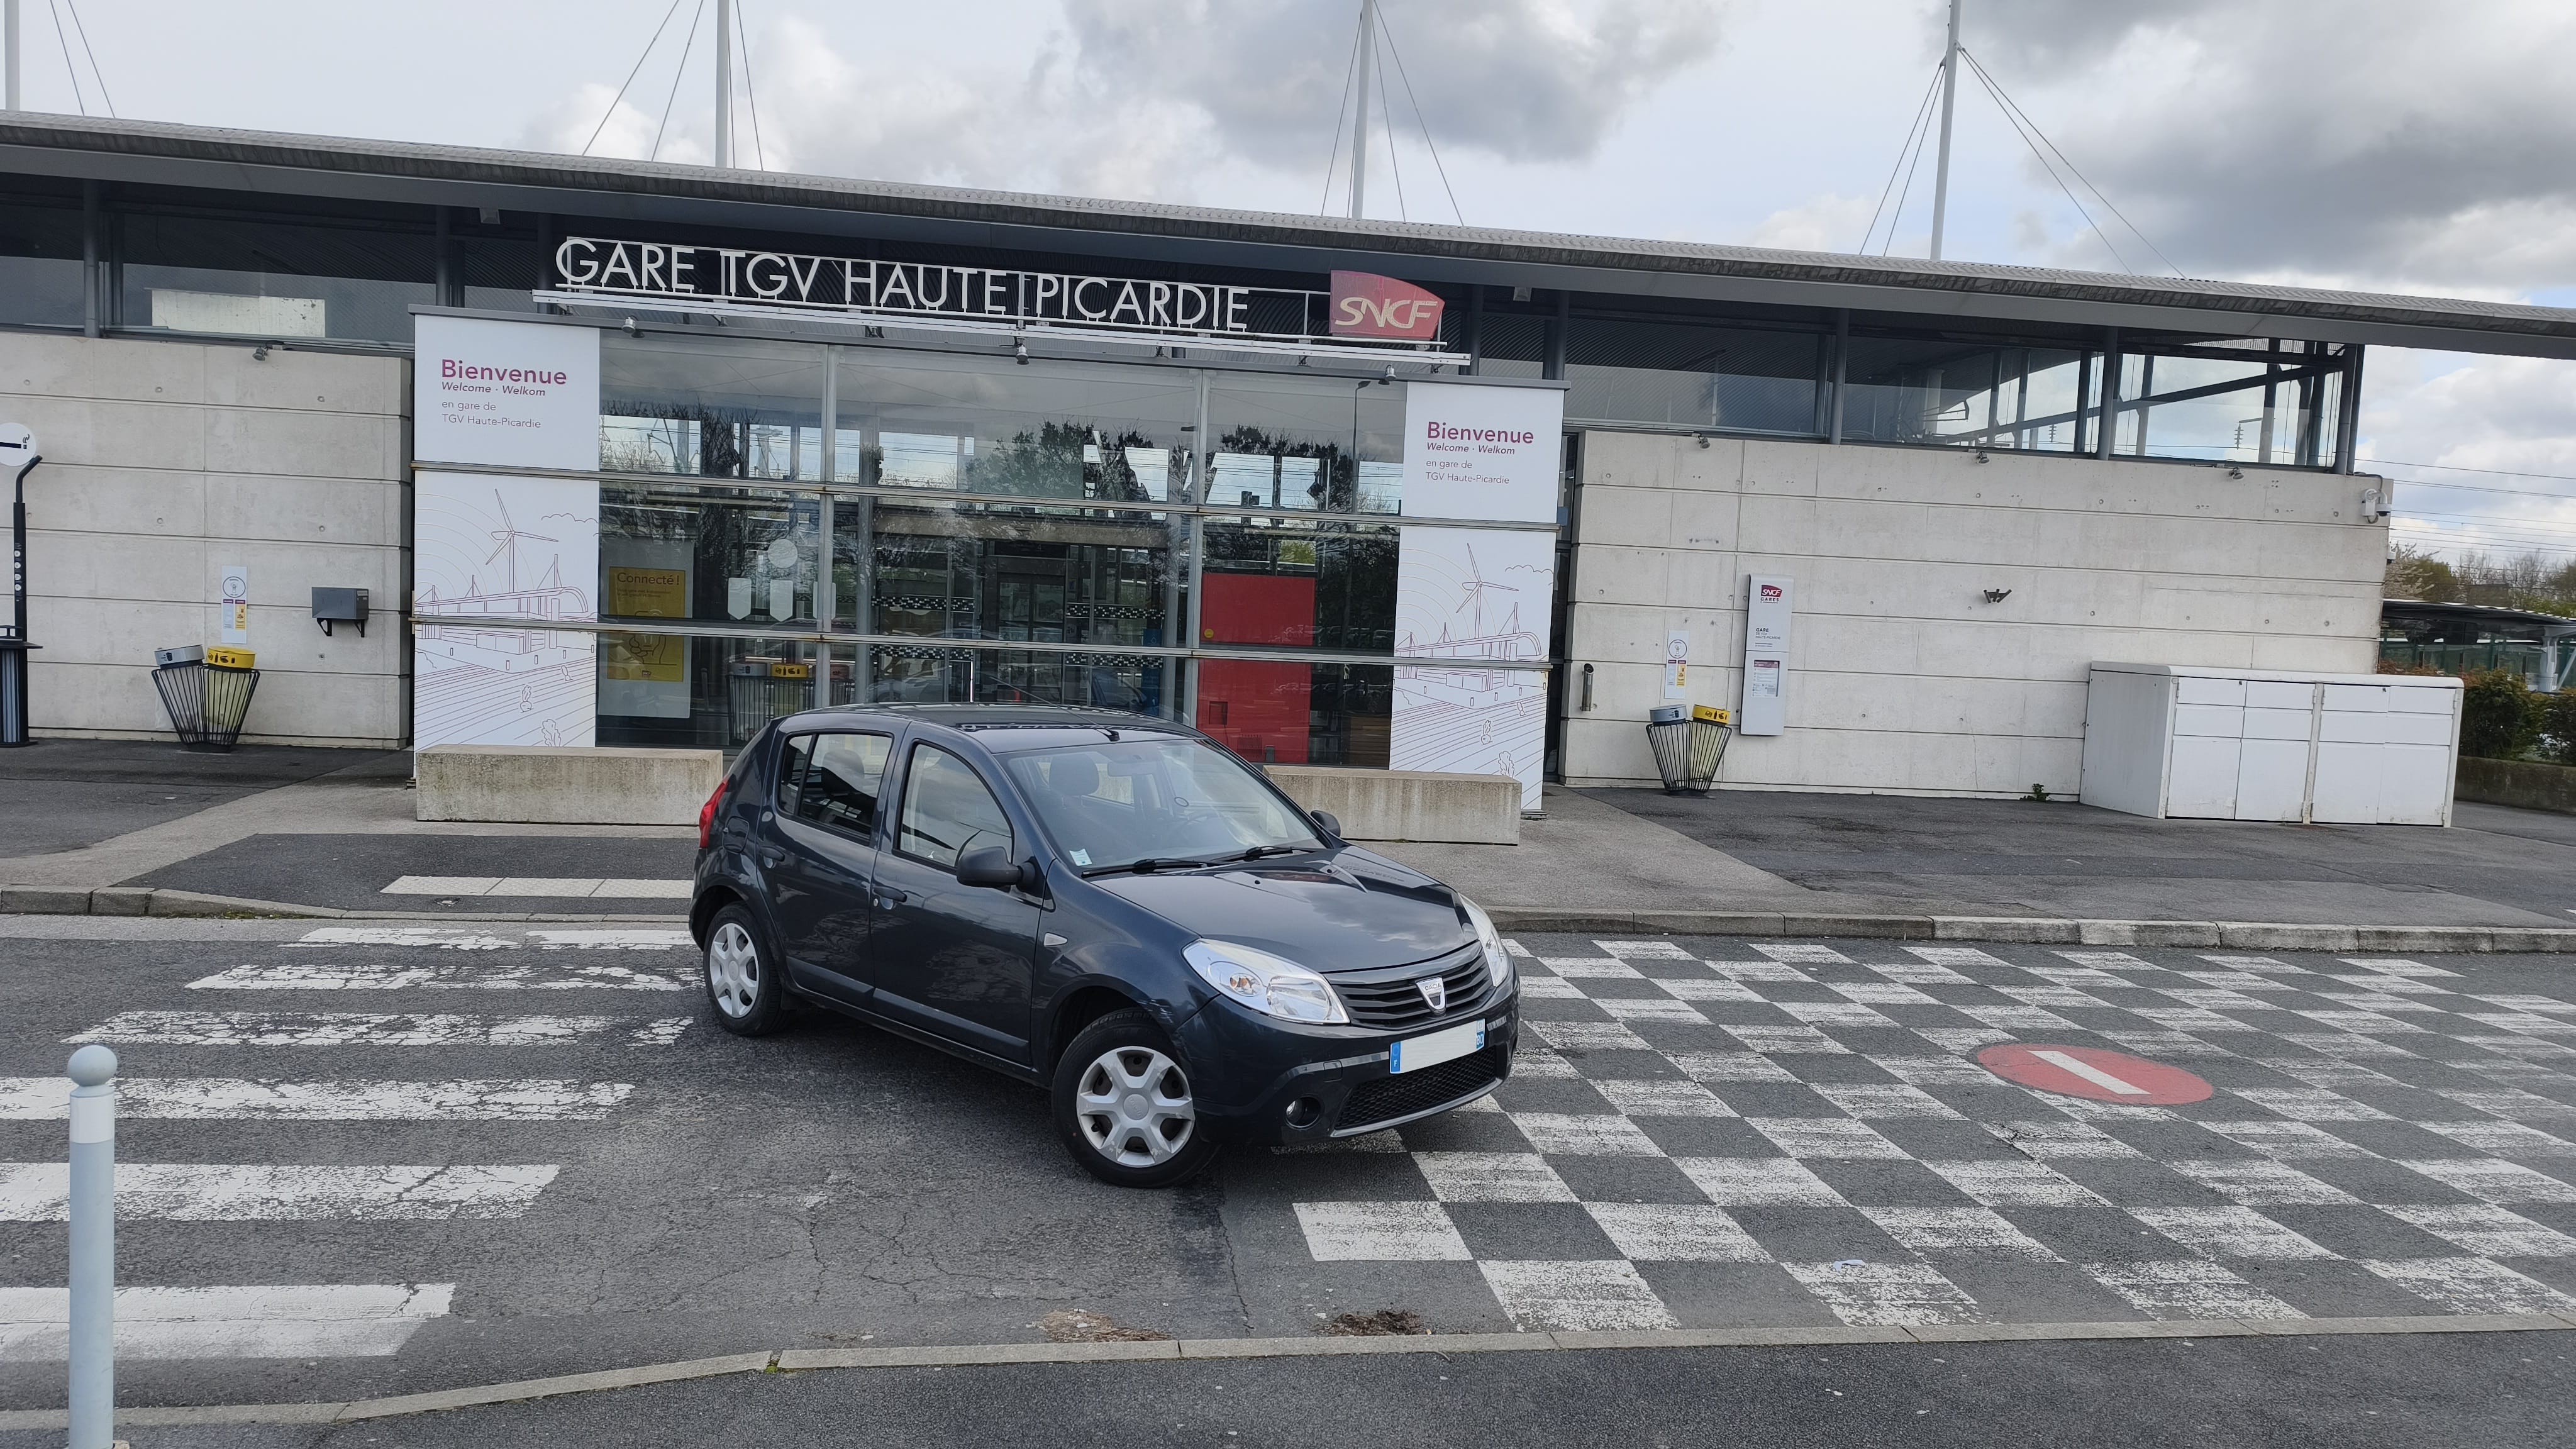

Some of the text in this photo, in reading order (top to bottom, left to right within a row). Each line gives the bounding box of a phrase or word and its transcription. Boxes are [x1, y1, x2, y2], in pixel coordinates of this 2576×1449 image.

[556, 238, 1248, 329] GARE TGV HAUTE PICARDIE
[1335, 297, 1438, 329] SNCF
[441, 358, 567, 385] Bienvenue
[441, 381, 546, 396] Welcome Welkom
[457, 402, 480, 411] gare
[483, 402, 496, 411] de
[441, 413, 541, 428] TGV Haute-Picardie
[1427, 421, 1534, 444] Bienvenue
[1427, 442, 1515, 455] Welcome Welkom
[1439, 460, 1458, 469] gare
[1461, 460, 1472, 469] de
[1426, 472, 1509, 484] TGV Haute-Picardie
[617, 572, 674, 585] Connecté
[1424, 983, 1441, 991] DACIA
